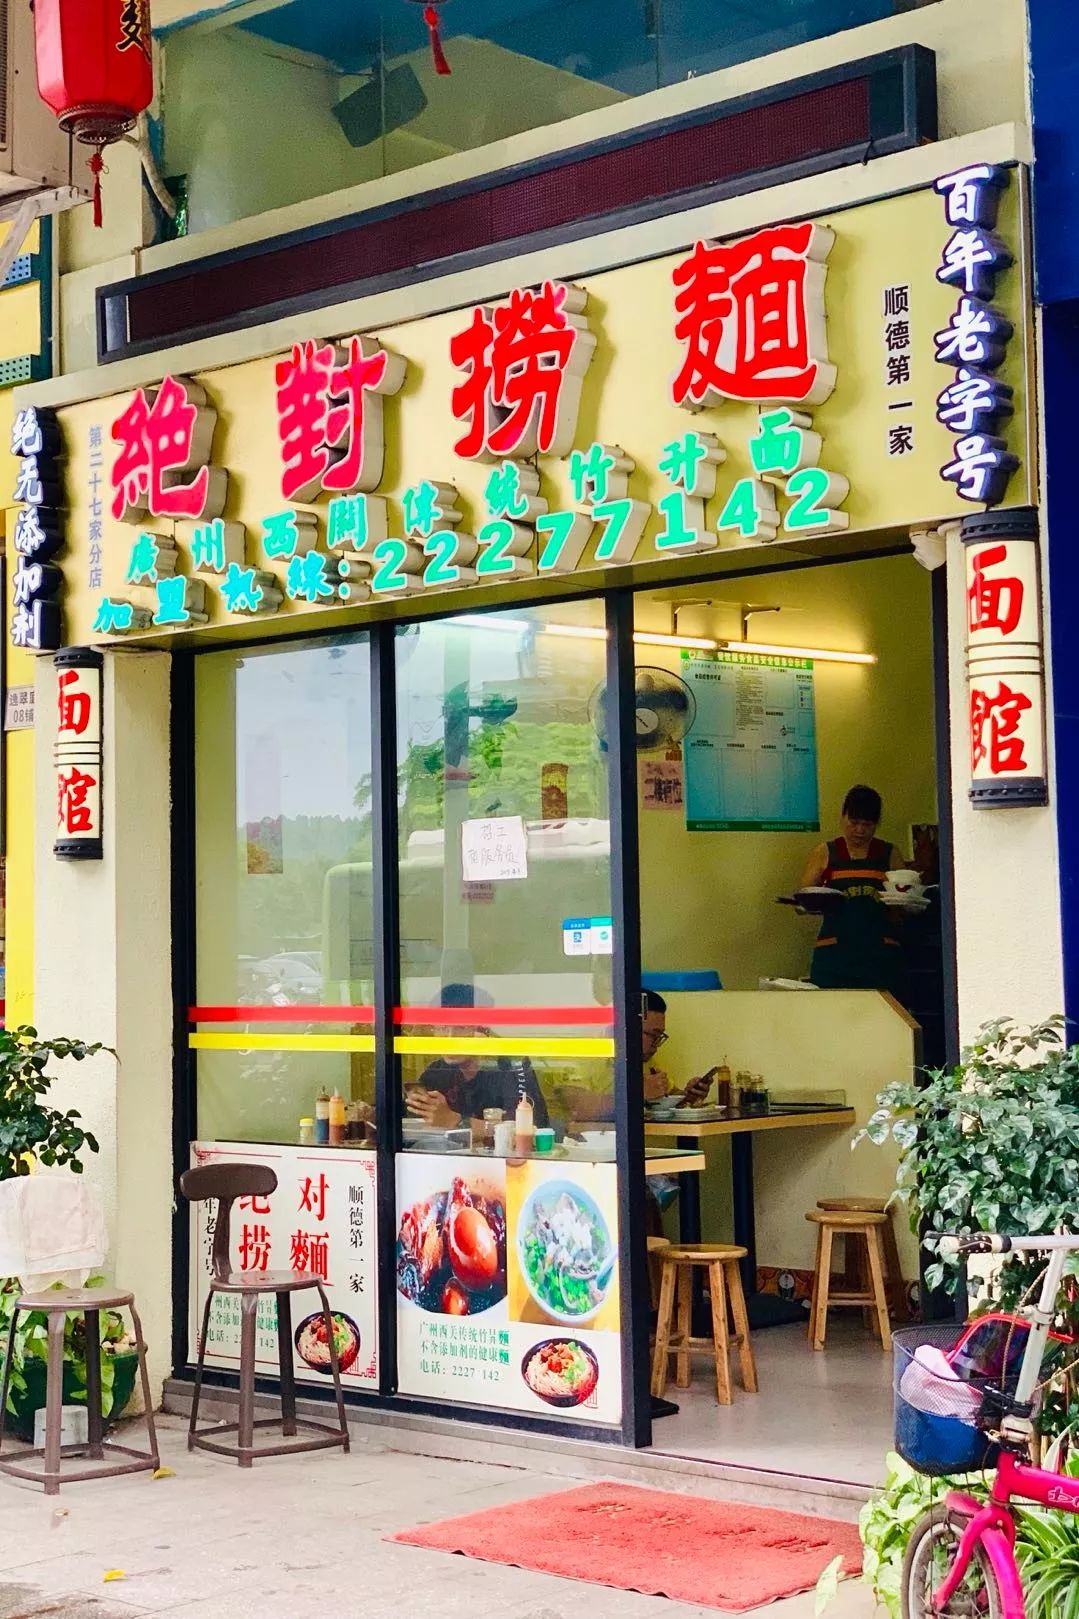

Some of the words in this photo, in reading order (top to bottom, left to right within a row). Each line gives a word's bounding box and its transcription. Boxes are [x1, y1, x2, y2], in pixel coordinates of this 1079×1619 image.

[883, 286, 914, 456] 顺德第一家
[935, 166, 997, 500] 百年老字号
[11, 406, 46, 650] 绝无添加剂
[88, 425, 103, 589] 第二十七家分店
[348, 1185, 365, 1294] 顺德第一家
